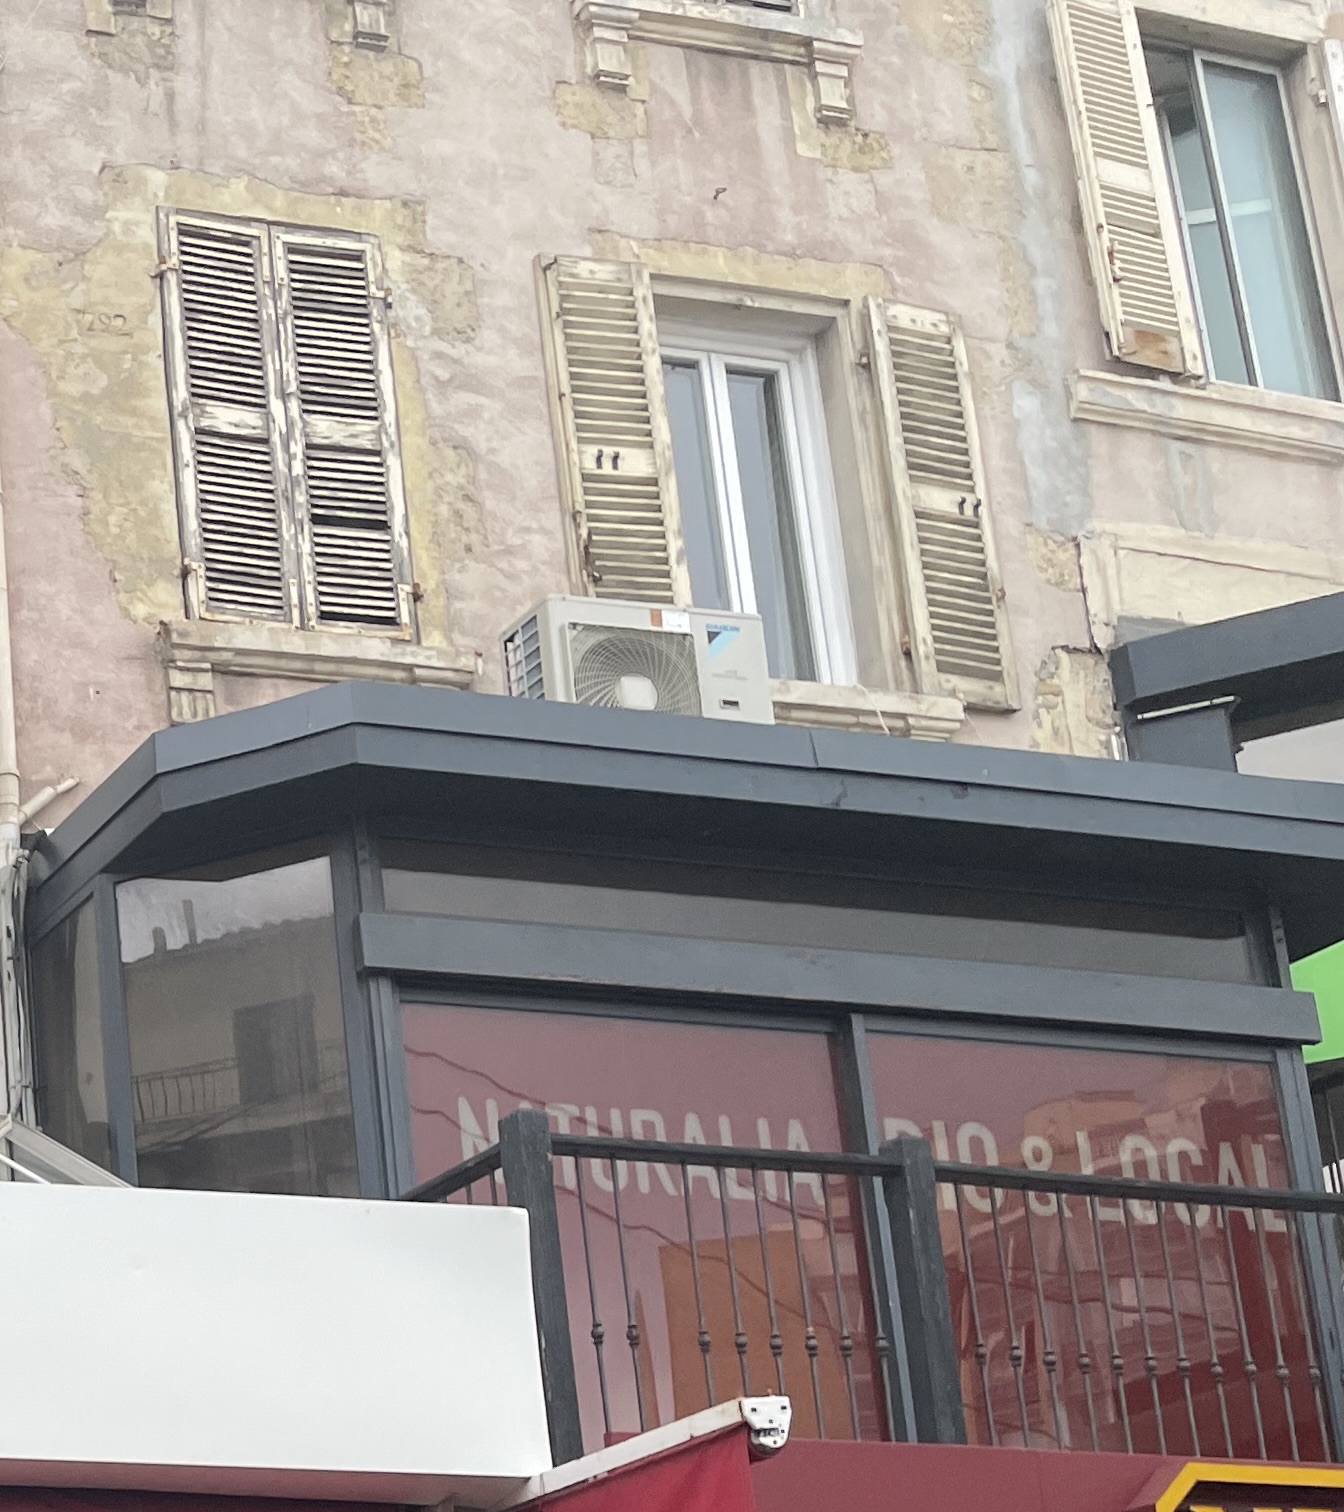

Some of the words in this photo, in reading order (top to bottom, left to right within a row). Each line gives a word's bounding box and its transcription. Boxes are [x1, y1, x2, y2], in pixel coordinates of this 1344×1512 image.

[457, 1096, 828, 1206] NTURALIA
[1021, 1143, 1062, 1217] &
[1079, 1131, 1287, 1233] LOCAL
